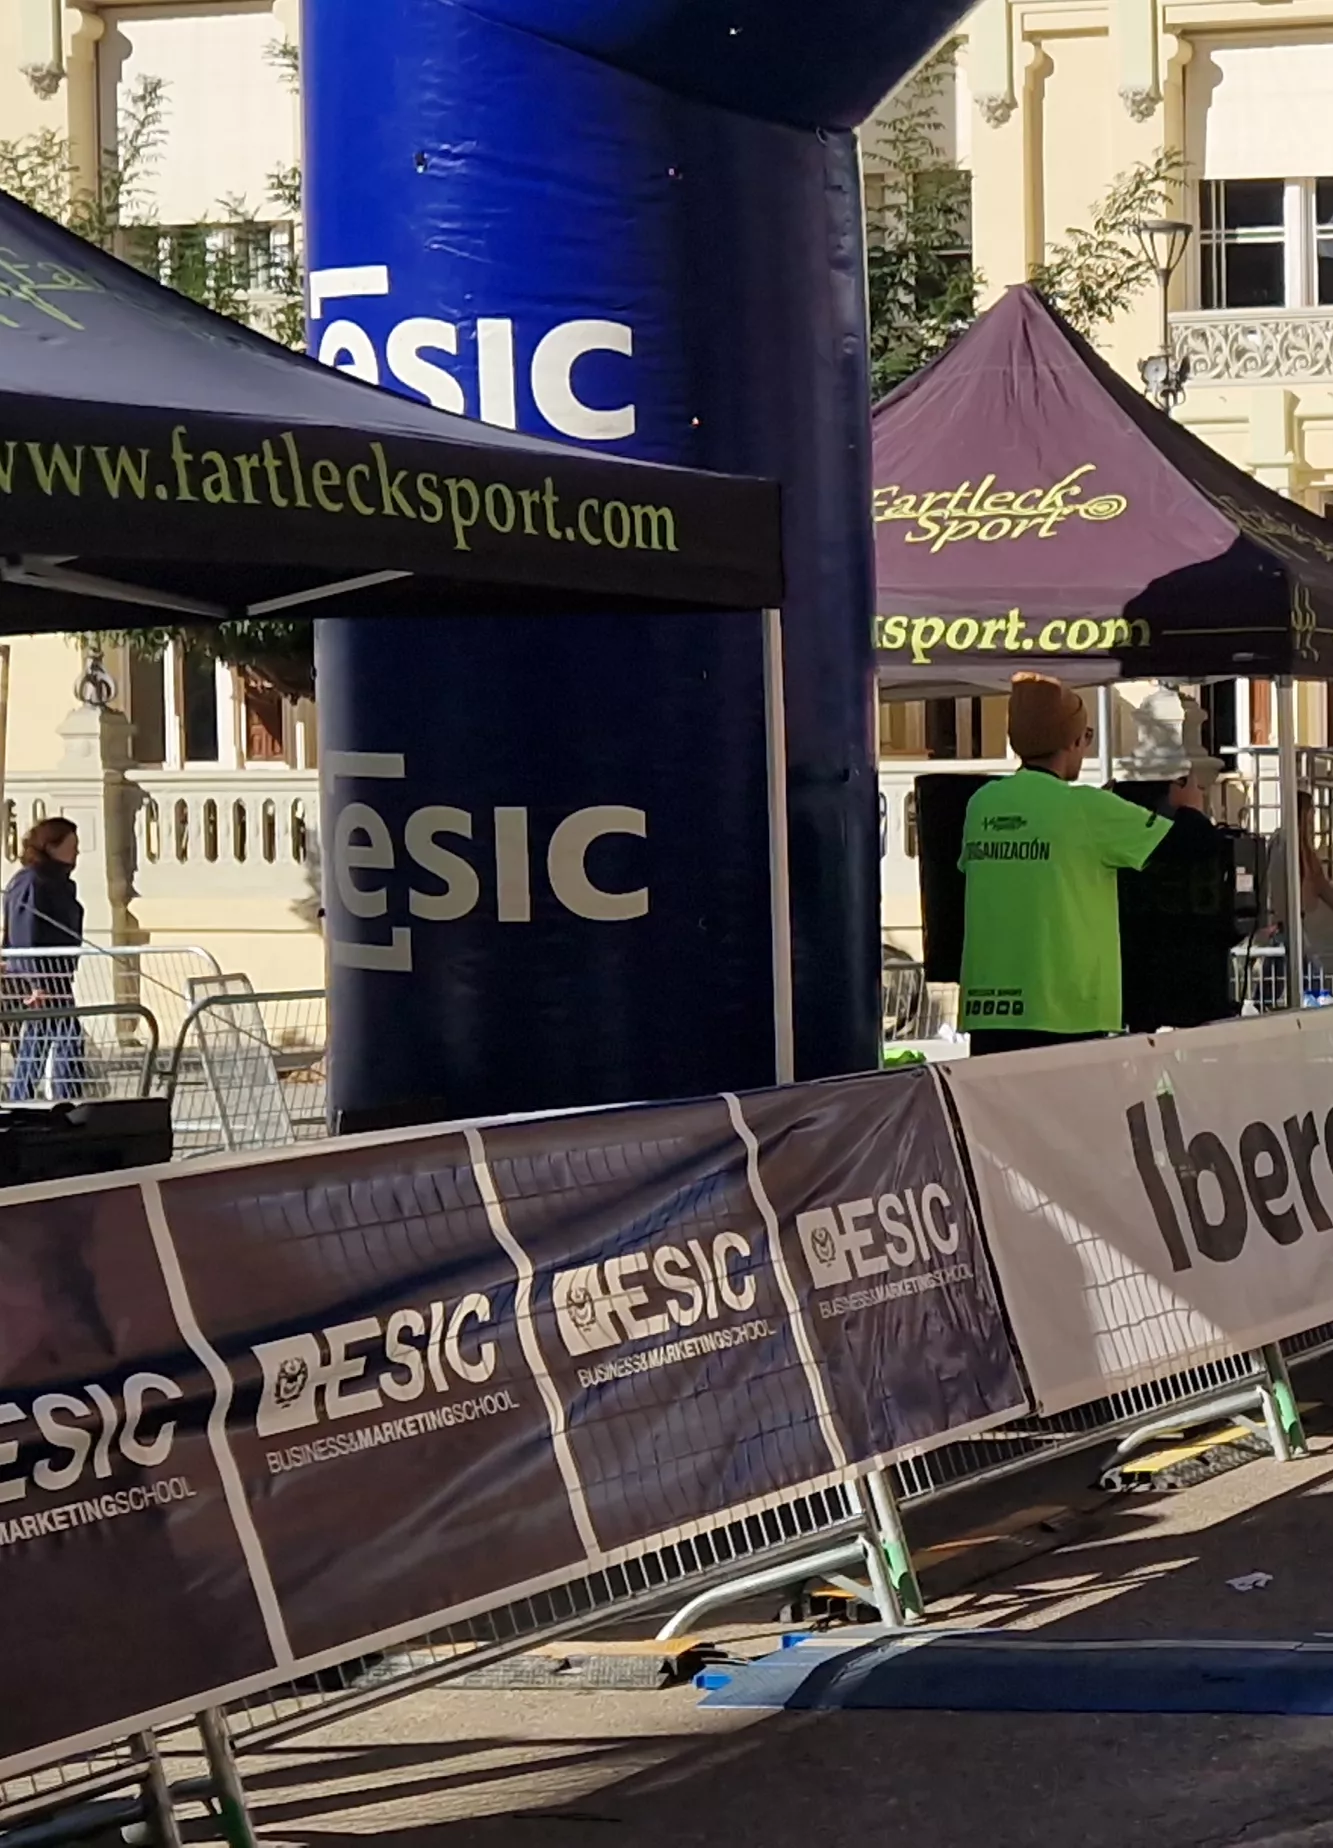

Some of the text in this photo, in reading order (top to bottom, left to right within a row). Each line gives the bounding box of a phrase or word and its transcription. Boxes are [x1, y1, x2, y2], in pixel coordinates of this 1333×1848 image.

[0, 427, 679, 553] ww.fartlecksport.com
[905, 508, 1066, 554] Sport
[600, 1231, 758, 1342] ESIC
[320, 1293, 498, 1420] ESIC
[265, 1389, 520, 1474] BUSINESS&MARKETINGSCHOOL
